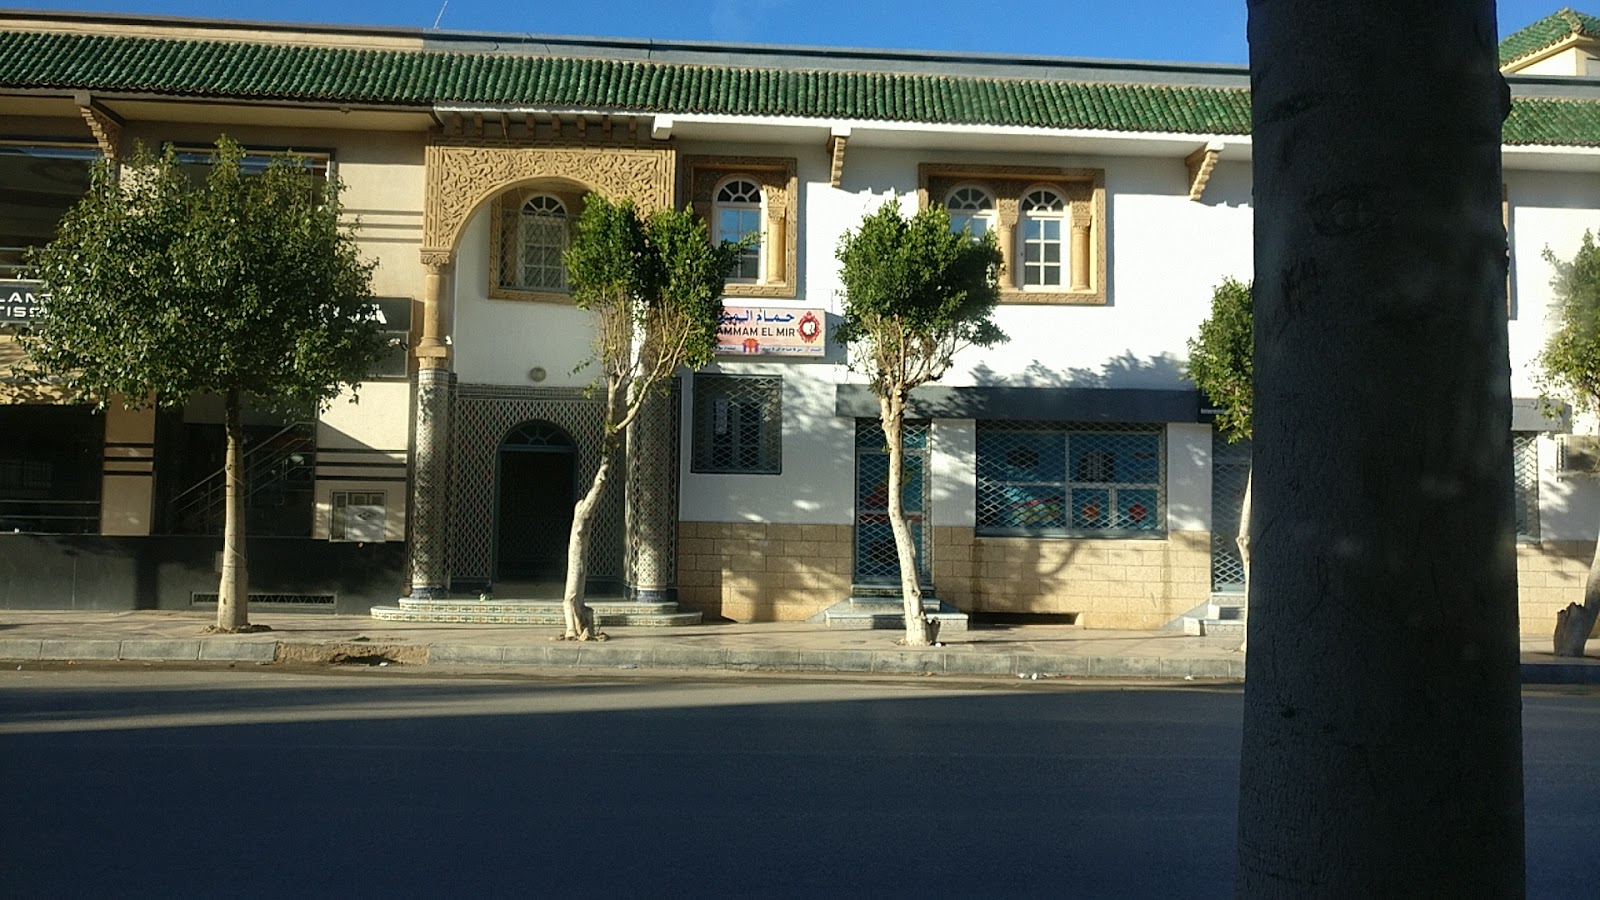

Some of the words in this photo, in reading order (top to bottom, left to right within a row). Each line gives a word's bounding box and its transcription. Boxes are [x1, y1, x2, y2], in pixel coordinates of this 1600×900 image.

[755, 308, 795, 325] حمام
[716, 327, 758, 337] AMMAM
[761, 327, 773, 337] EL
[776, 328, 796, 337] MIR
